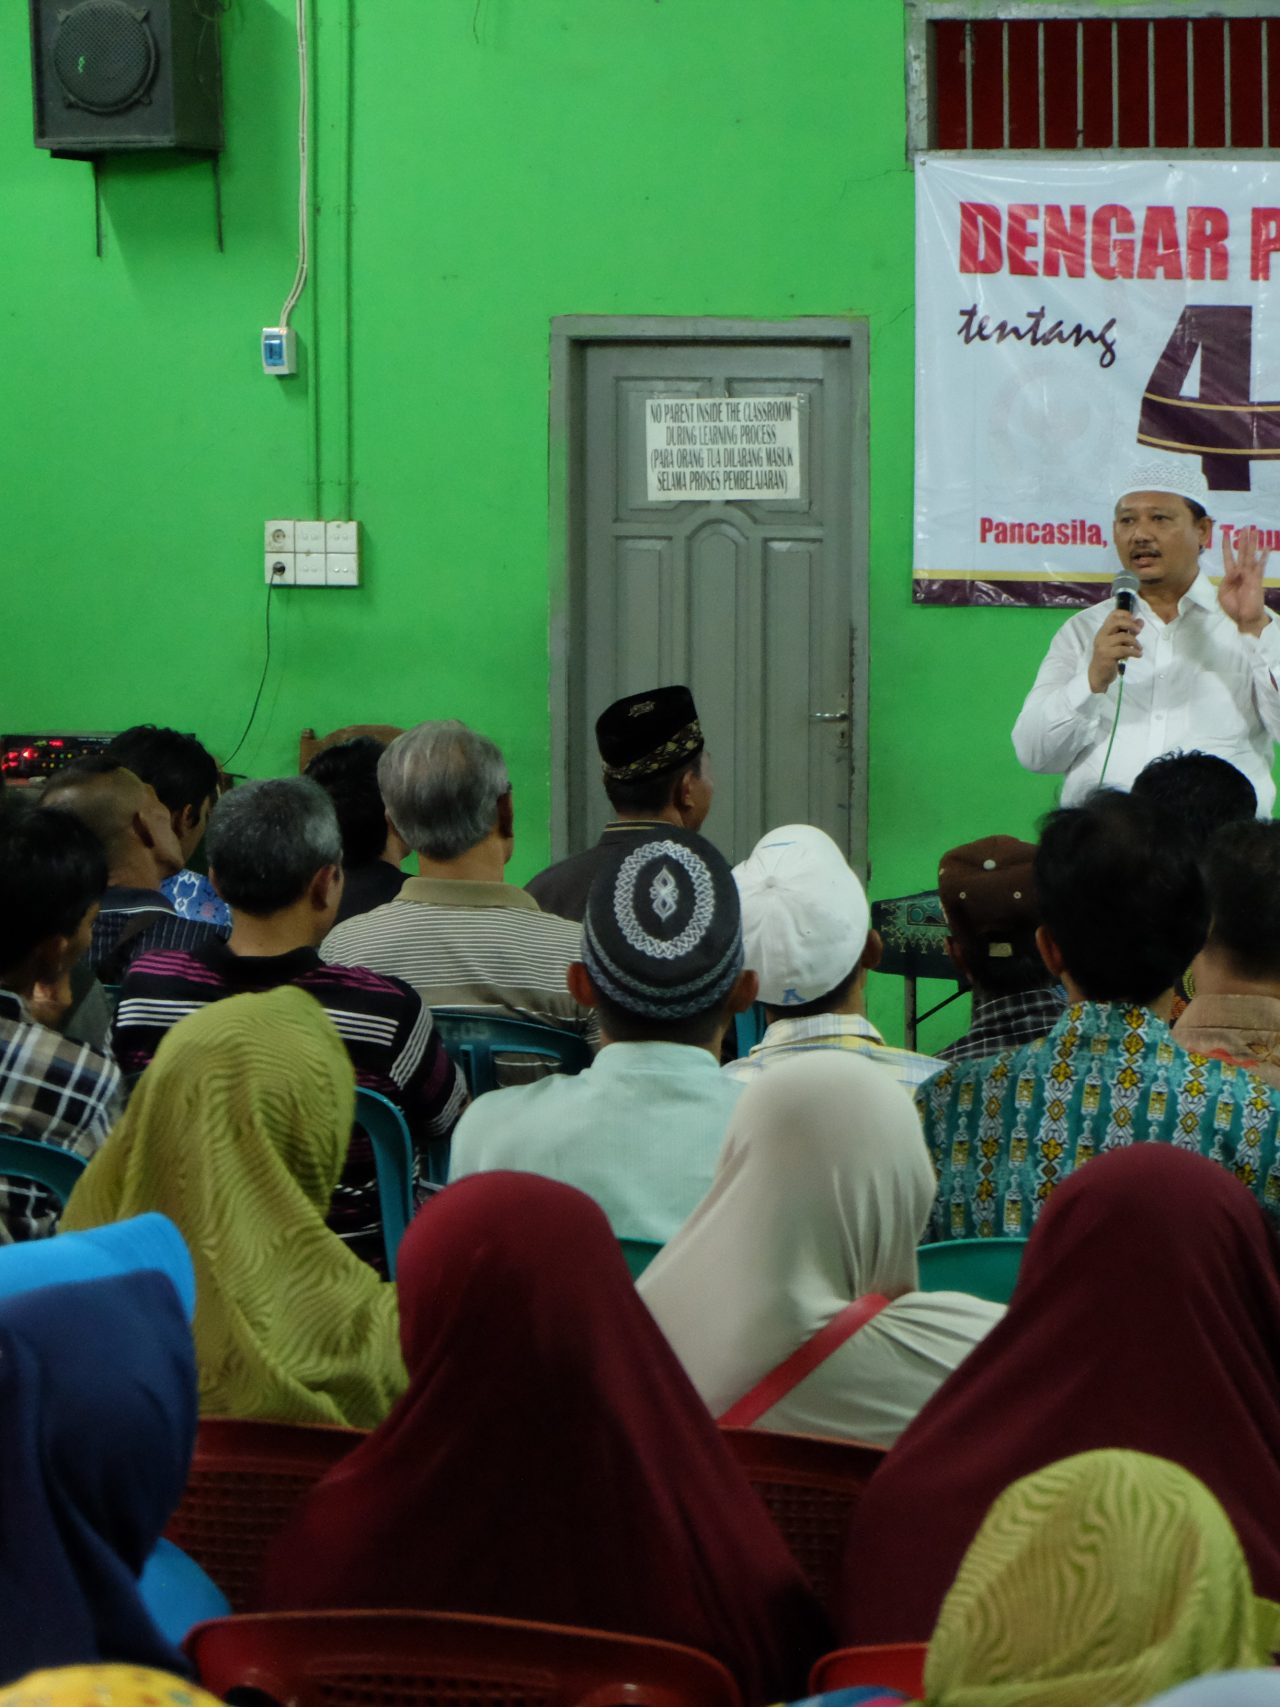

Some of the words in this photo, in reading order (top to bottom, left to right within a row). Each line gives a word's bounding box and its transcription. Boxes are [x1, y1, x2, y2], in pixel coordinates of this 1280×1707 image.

[959, 201, 1230, 281] DENGAR
[957, 303, 1118, 369] tentang
[650, 402, 662, 424] NO
[664, 402, 695, 424] PARENT
[696, 402, 724, 423] INSIDE
[725, 401, 742, 423] THE
[743, 401, 792, 422] CLASSROOM
[1137, 305, 1253, 491] 4
[666, 425, 698, 446] DURING
[699, 424, 738, 446] LEARNING
[740, 424, 777, 445] PROCESS
[650, 449, 674, 471] (PARA
[676, 448, 705, 469] ORANG
[706, 448, 721, 468] TUA
[723, 447, 764, 468] DILARANG
[765, 446, 794, 468] MASUK
[656, 471, 688, 491] SELAMA
[689, 470, 722, 491] PROSES
[723, 469, 788, 494] PEMBELAJARAN)
[979, 516, 1108, 549] Pancasila,
